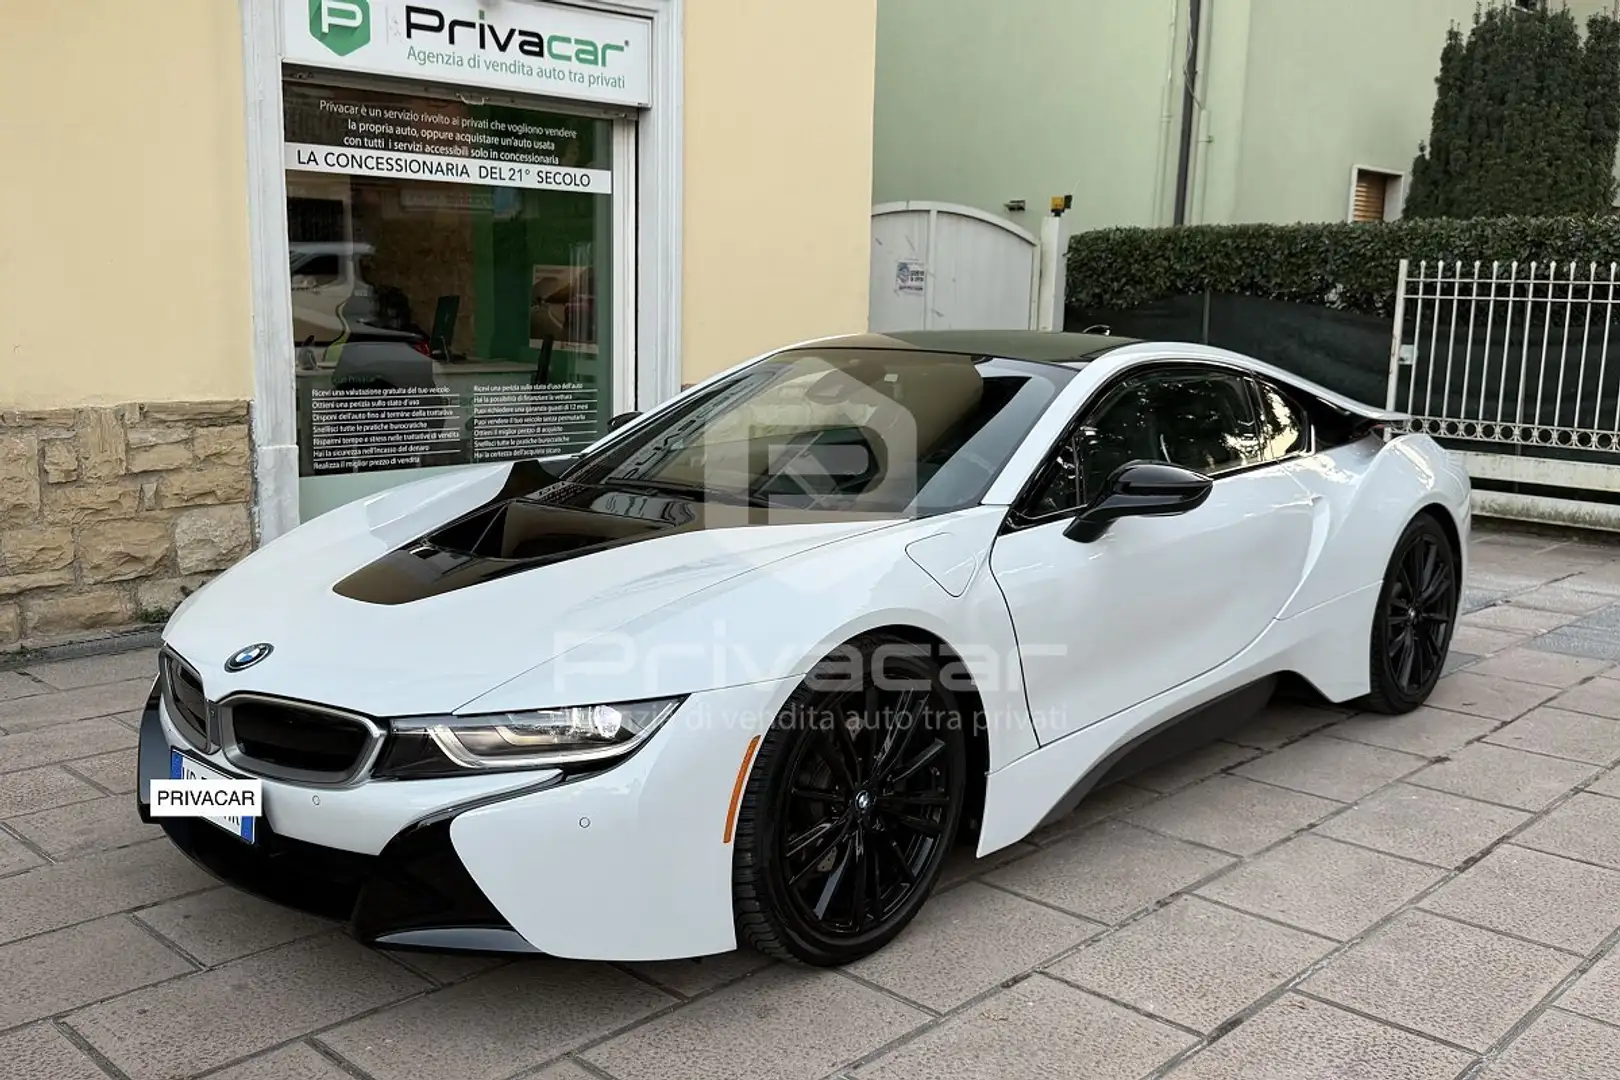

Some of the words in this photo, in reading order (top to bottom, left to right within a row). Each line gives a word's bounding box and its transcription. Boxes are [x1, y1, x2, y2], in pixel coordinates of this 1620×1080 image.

[405, 5, 625, 68] Privacar
[407, 46, 464, 66] Agenzia
[468, 54, 481, 69] di
[484, 58, 533, 76] vendita
[536, 66, 566, 81] auto
[568, 69, 585, 83] tra
[588, 72, 625, 88] privati
[319, 100, 358, 115] Privacar
[368, 108, 382, 118] un
[383, 109, 420, 122] servizio
[421, 112, 450, 125] rivolto
[452, 116, 460, 126] ai
[461, 117, 489, 130] privati
[490, 120, 506, 131] che
[507, 122, 544, 135] vogliono
[544, 126, 578, 139] vendere
[348, 119, 357, 130] la
[358, 121, 394, 136] propria
[395, 126, 420, 138] auto,
[420, 129, 454, 141] oppure
[455, 131, 500, 146] acquistare
[500, 136, 532, 148] un'auto
[533, 140, 556, 151] usata
[297, 150, 319, 166] LA
[324, 152, 471, 178] CONCESSIONARIA
[536, 170, 591, 188] SECOLO
[343, 136, 362, 146] con
[364, 137, 385, 149] tutti
[388, 139, 392, 149] i
[394, 141, 424, 152] servizi
[470, 145, 489, 158] solo
[489, 147, 498, 159] in
[500, 150, 560, 165] concessionaria
